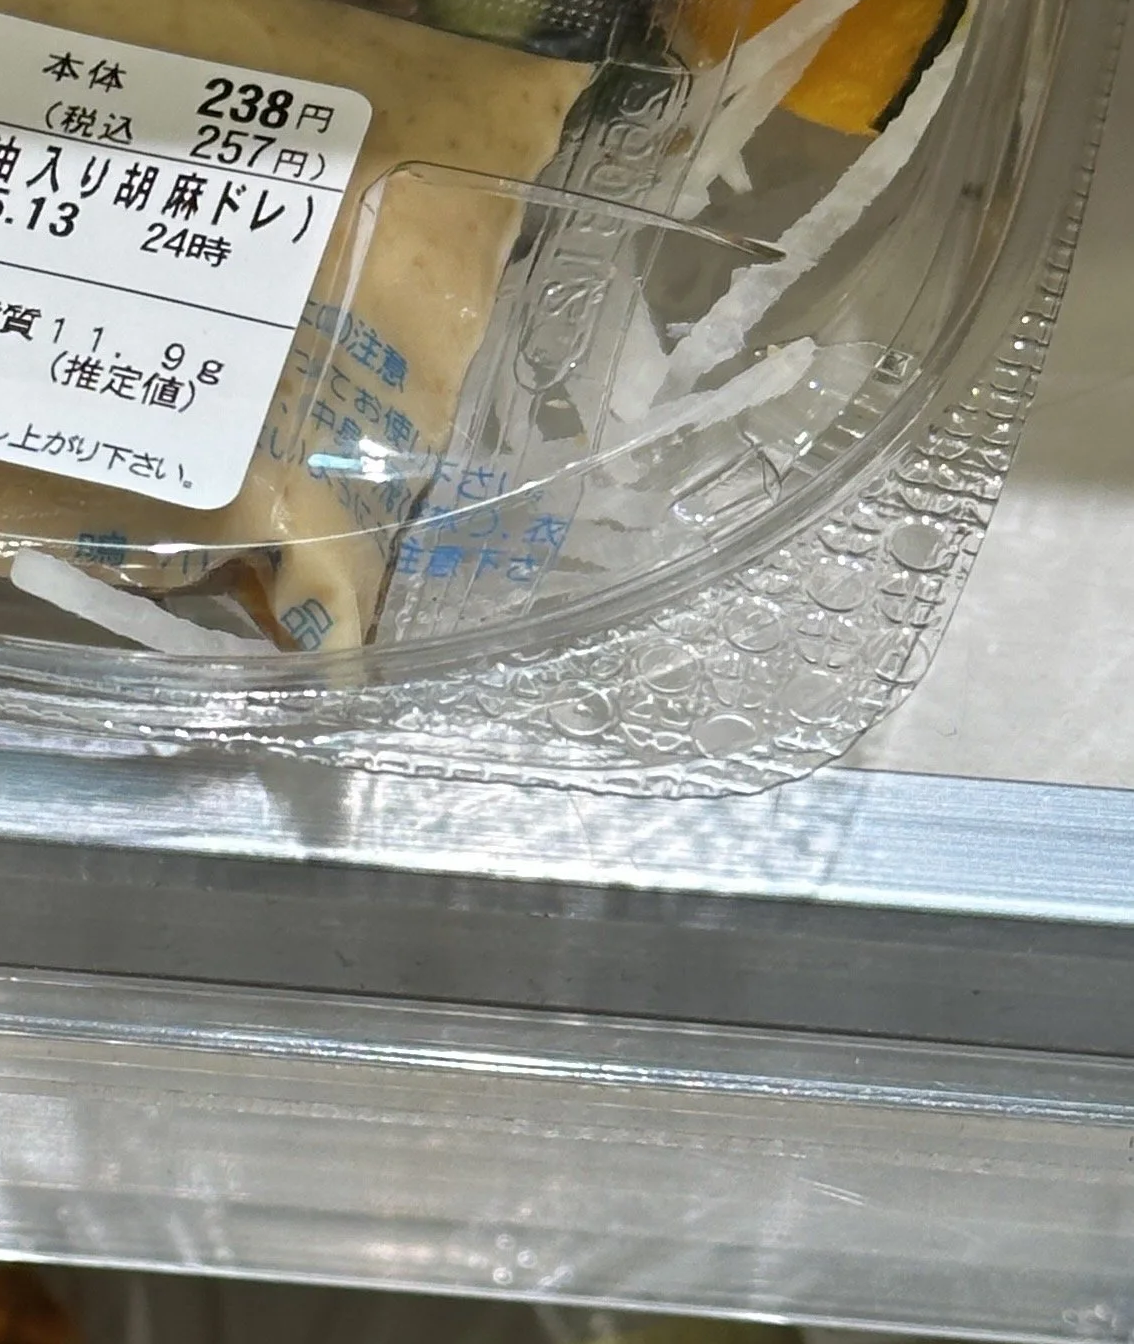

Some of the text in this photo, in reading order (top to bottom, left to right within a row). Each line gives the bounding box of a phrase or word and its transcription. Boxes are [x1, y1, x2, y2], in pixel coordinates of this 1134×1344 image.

[41, 50, 336, 134] 本体 238円
[44, 99, 330, 183] (税込 257円)
[139, 222, 233, 269] 24時
[48, 350, 201, 413] (推定値)
